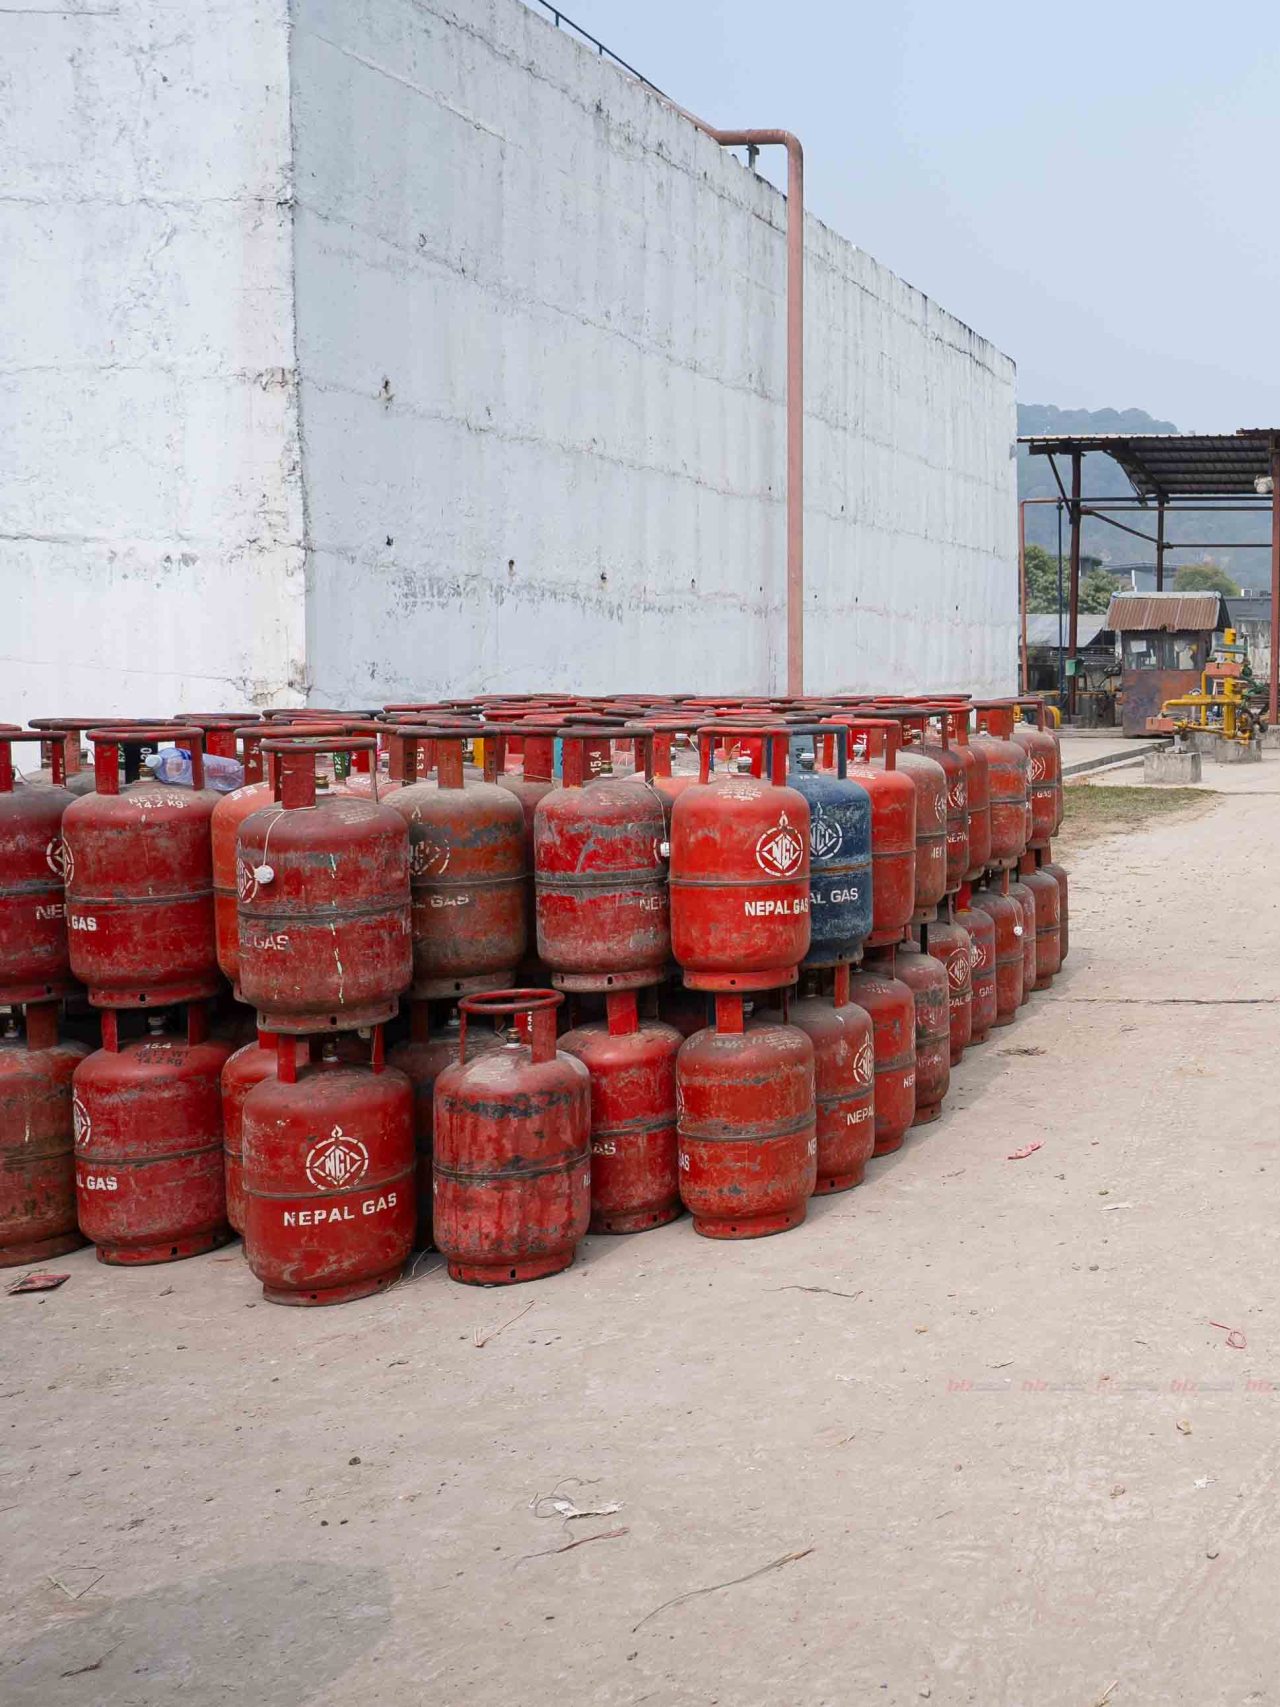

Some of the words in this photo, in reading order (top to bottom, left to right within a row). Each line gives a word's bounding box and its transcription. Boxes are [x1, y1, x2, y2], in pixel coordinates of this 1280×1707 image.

[589, 751, 601, 773] 15.4
[135, 800, 165, 809] 14.2
[830, 887, 859, 903] GAS
[744, 900, 791, 917] NEPAL
[793, 898, 809, 914] GAS
[72, 915, 97, 932] GAS
[253, 935, 289, 951] GAS
[87, 1176, 118, 1191] GAS
[283, 1206, 355, 1227] NEPAL
[362, 1193, 397, 1216] GAS
